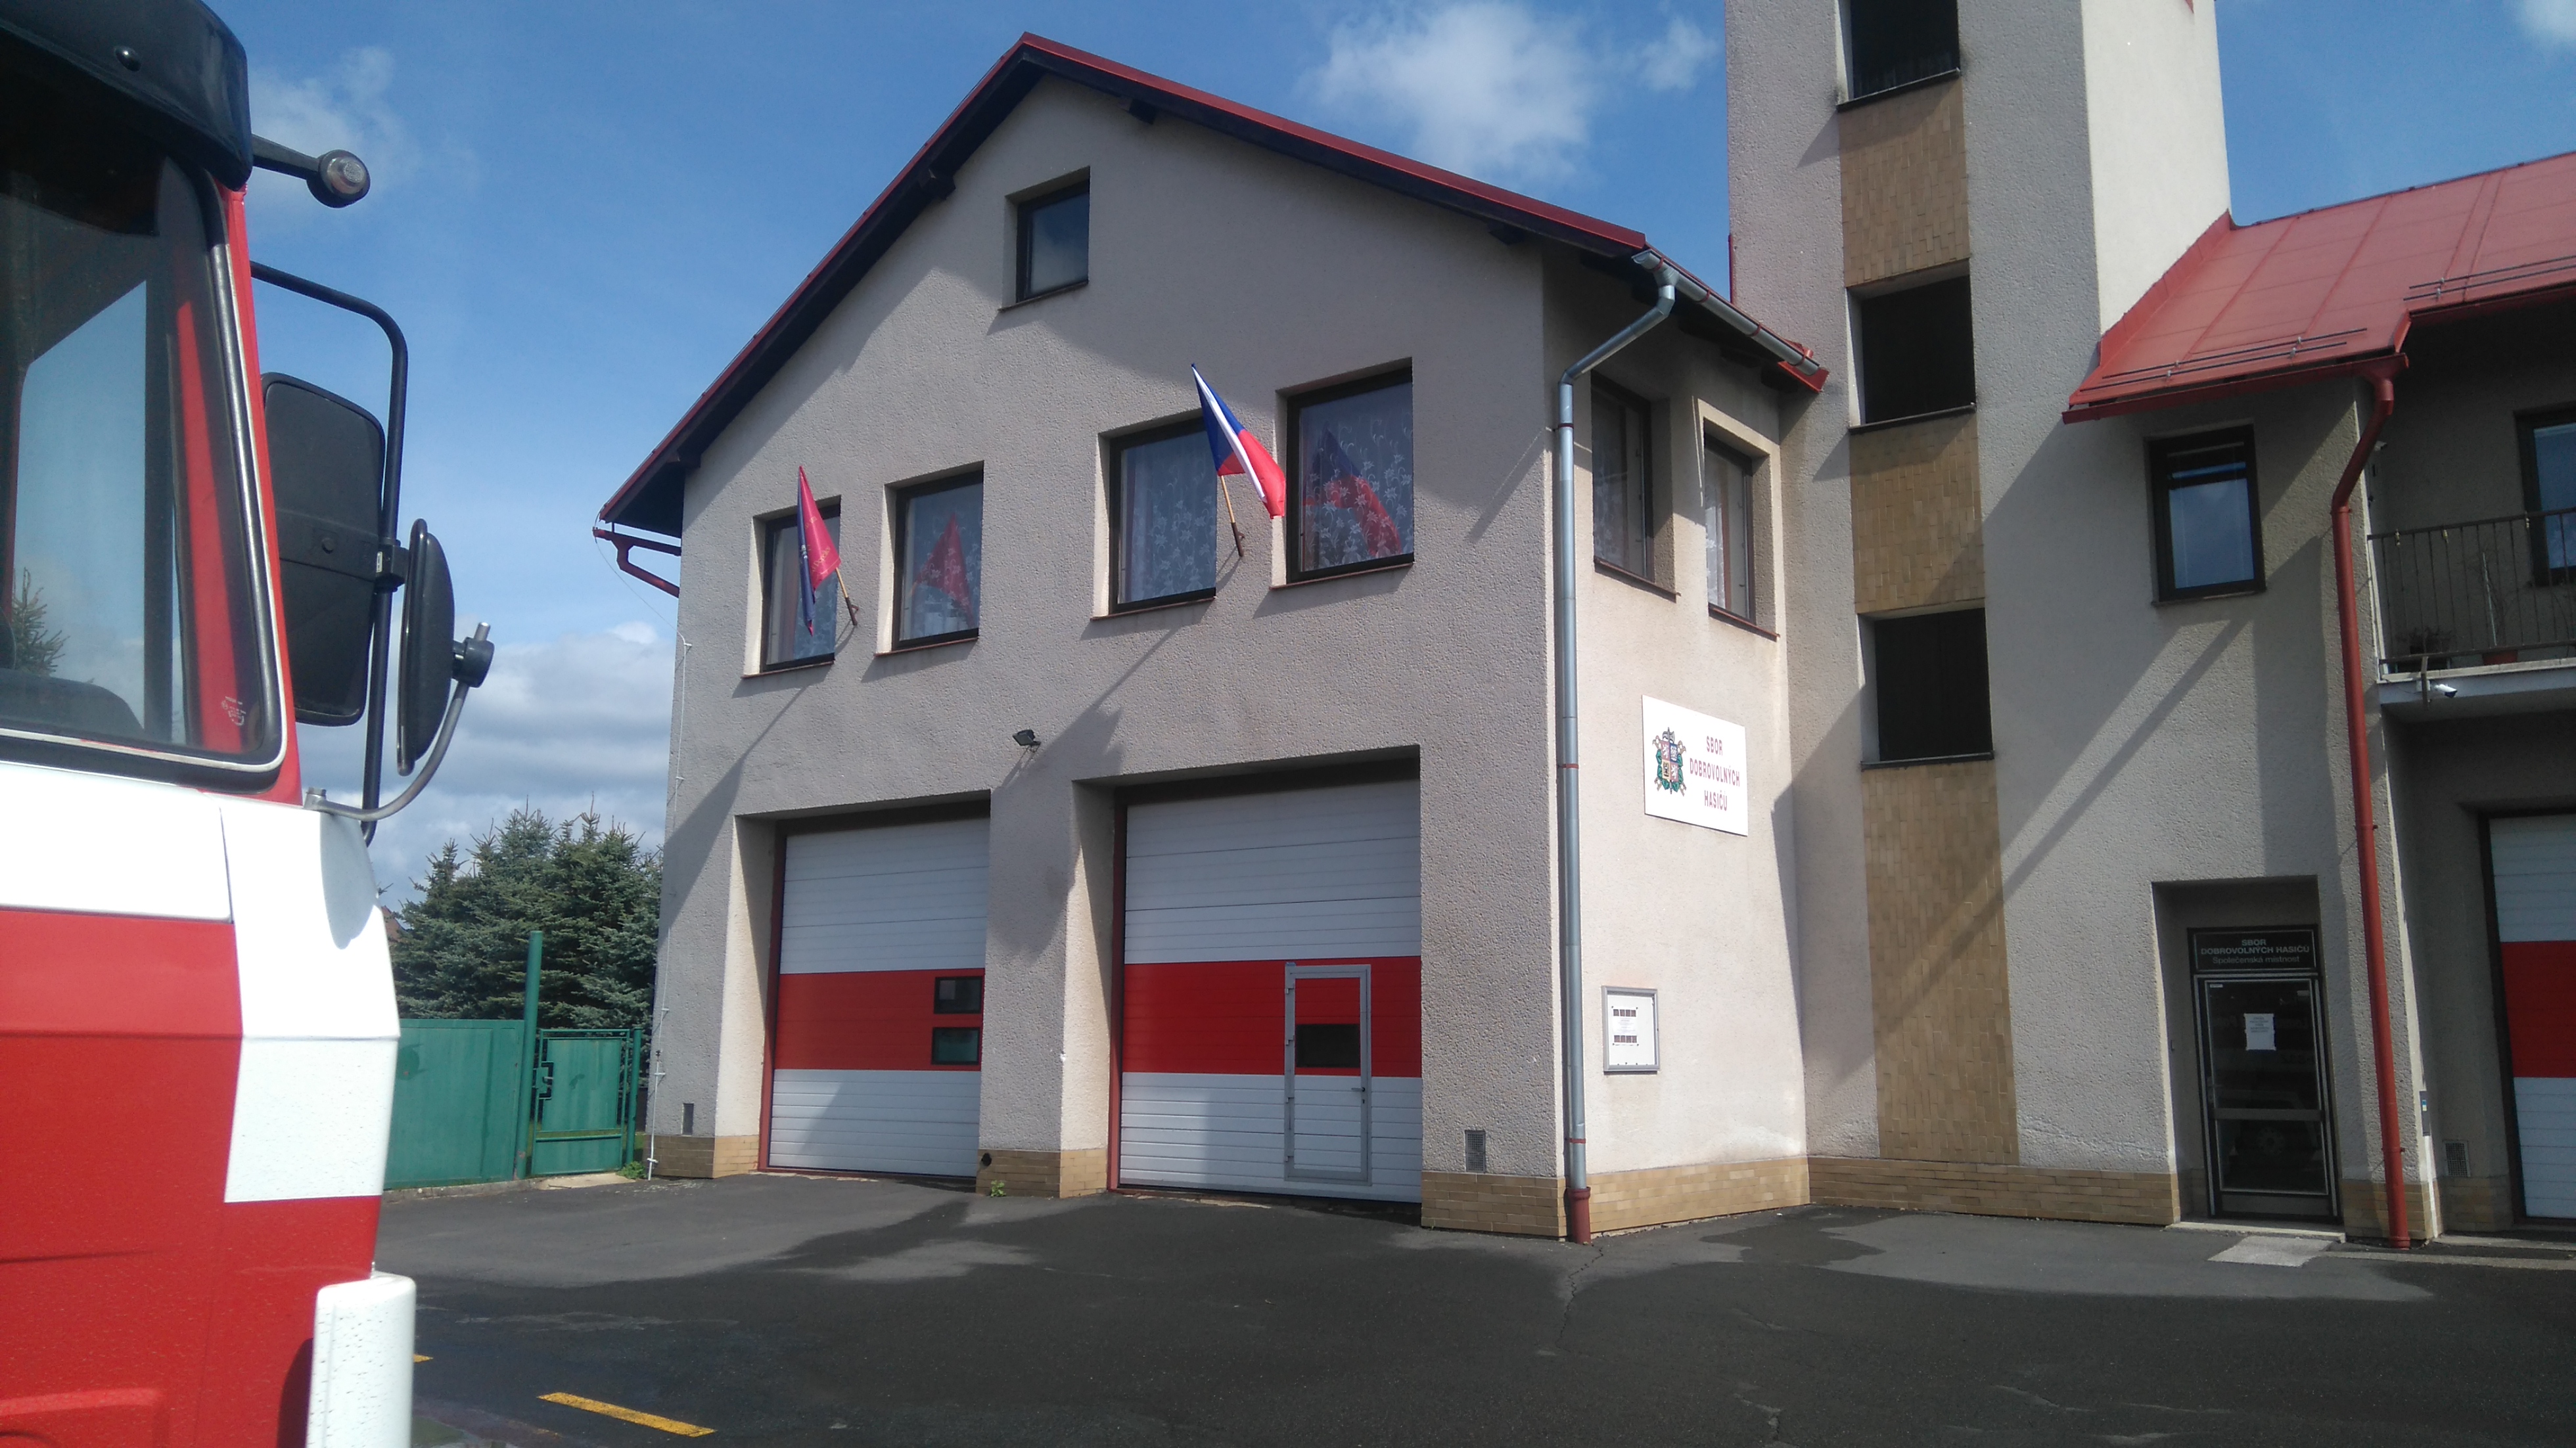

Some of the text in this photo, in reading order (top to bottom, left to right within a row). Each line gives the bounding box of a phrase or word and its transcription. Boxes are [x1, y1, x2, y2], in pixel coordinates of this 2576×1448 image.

[1706, 735, 1723, 756] SBOR
[1690, 758, 1740, 786] DOBROVOLNÝCH
[2201, 945, 2274, 955] DOBROVOLNÝCH
[2213, 956, 2263, 964] Společenská
